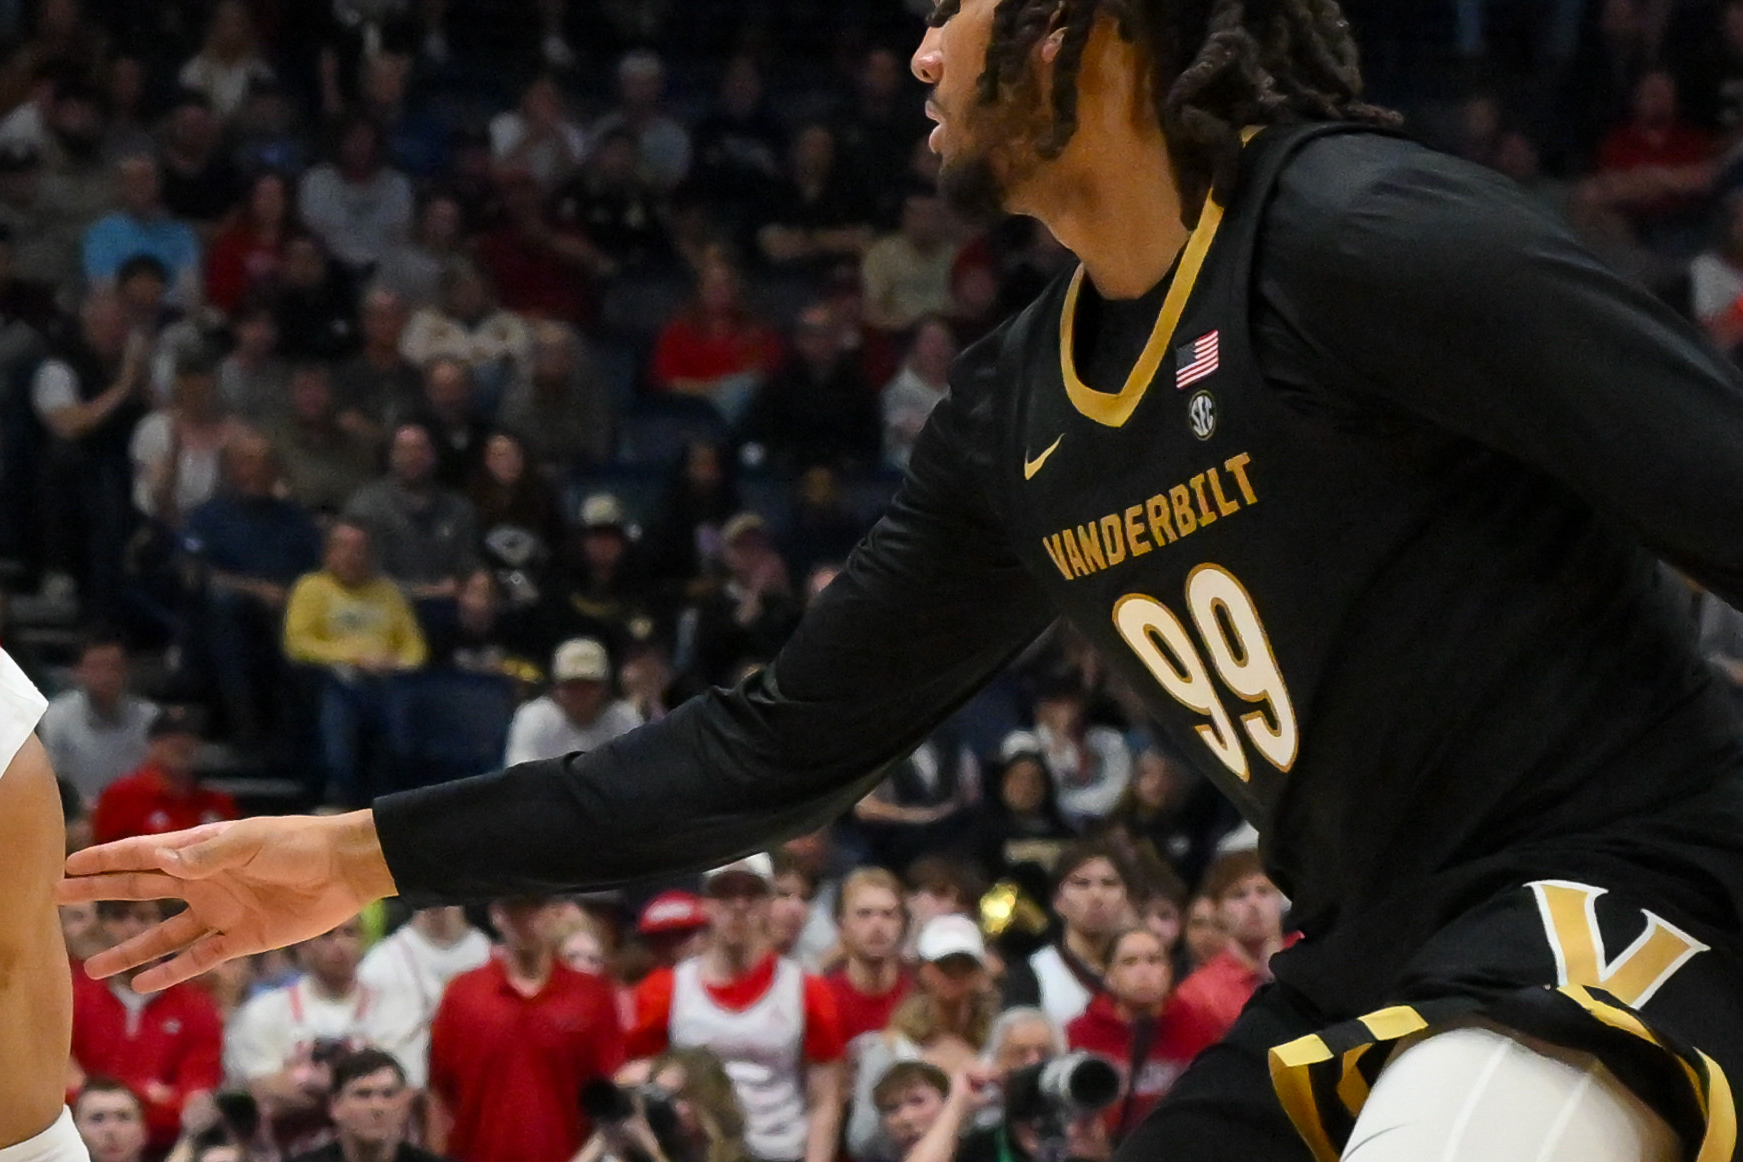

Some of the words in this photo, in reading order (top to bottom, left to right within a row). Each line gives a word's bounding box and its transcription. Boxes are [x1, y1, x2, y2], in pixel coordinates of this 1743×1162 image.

[1042, 451, 1258, 581] VANDERBILT
[1112, 561, 1298, 782] 99
[1523, 878, 1711, 1011] V
